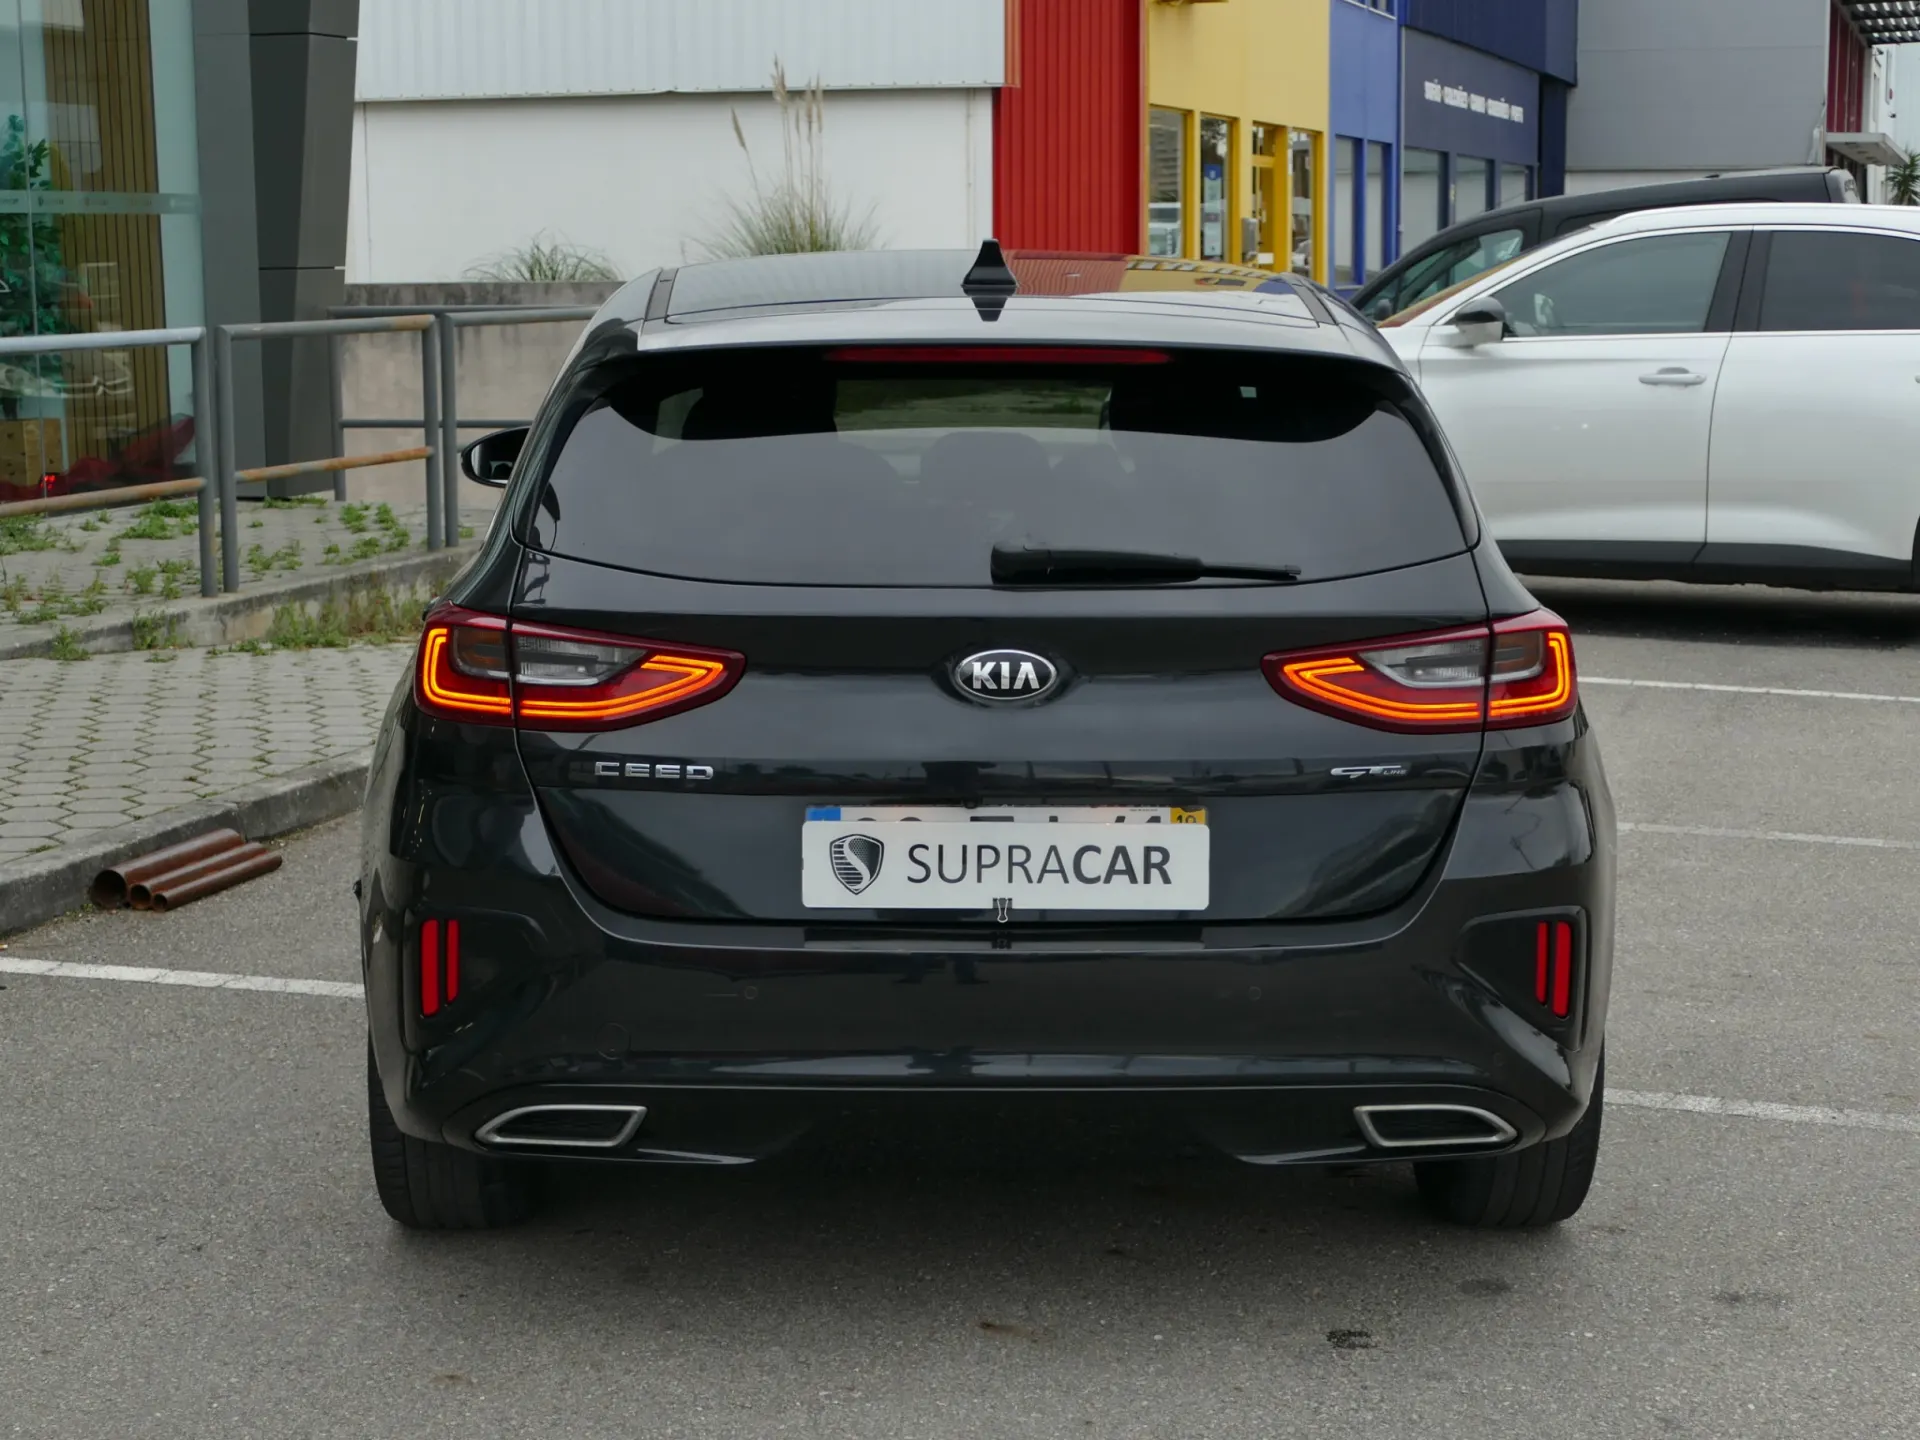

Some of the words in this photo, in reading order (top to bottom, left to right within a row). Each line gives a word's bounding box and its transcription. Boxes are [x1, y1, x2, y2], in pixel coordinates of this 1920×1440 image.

[972, 661, 1040, 690] KIA
[594, 761, 714, 780] CEED
[1330, 765, 1401, 779] GT
[906, 843, 1172, 886] SUPRACAR
